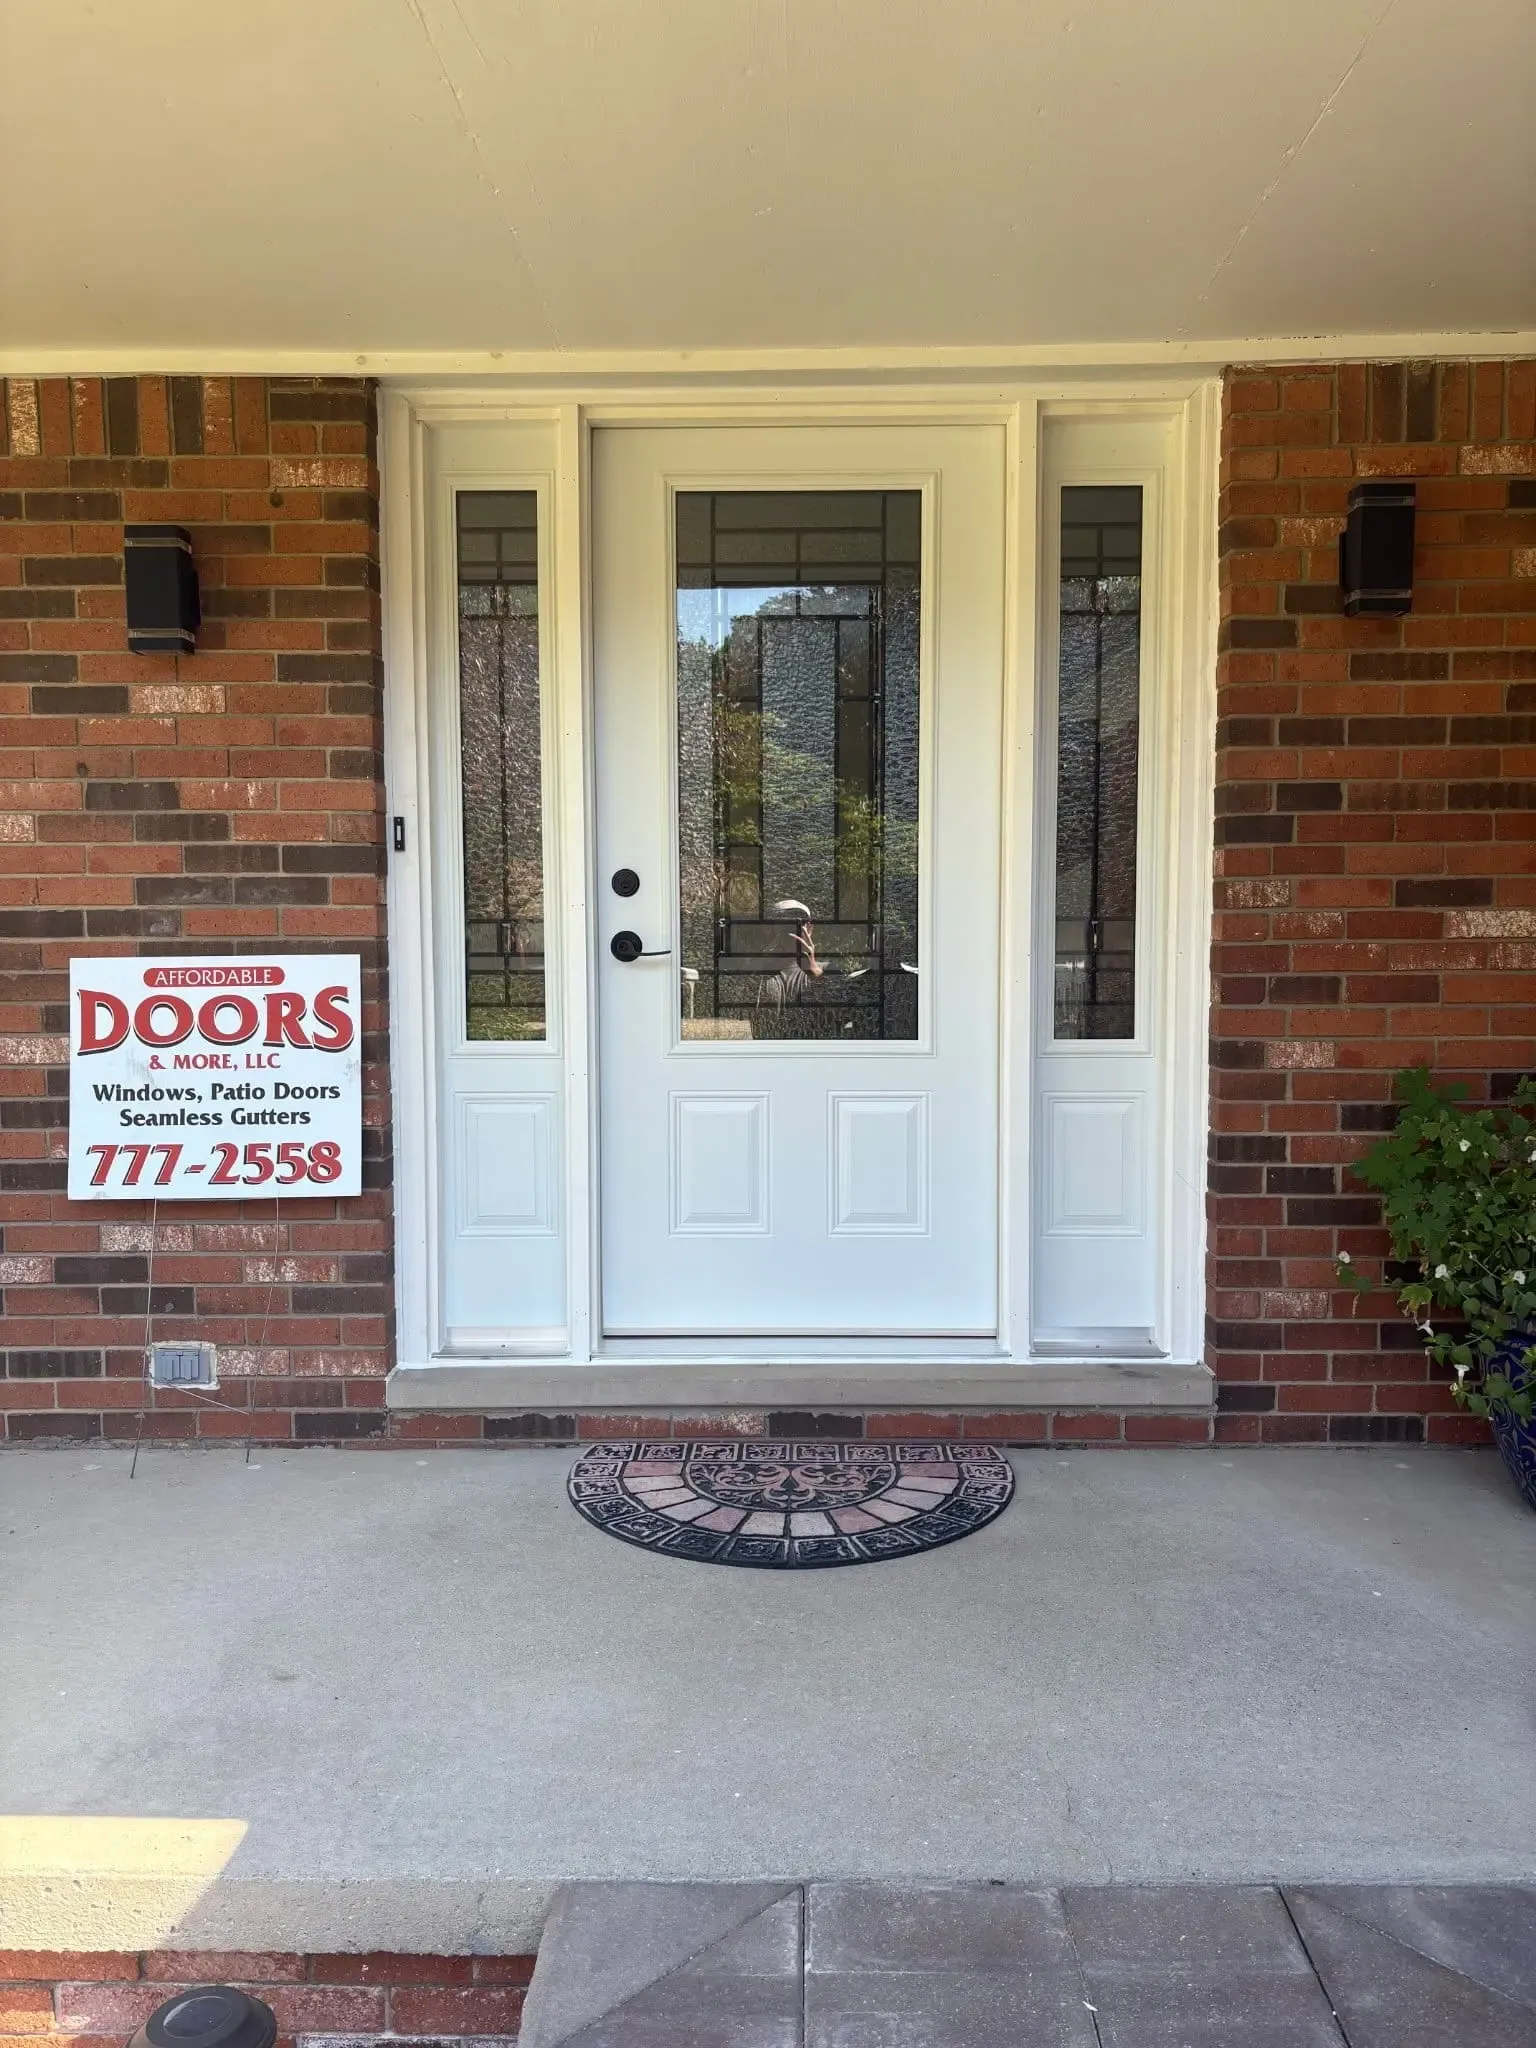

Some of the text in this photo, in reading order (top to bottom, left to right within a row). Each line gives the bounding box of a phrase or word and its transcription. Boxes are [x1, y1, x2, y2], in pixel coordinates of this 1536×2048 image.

[155, 967, 273, 985] AFFORDABLE
[77, 986, 355, 1056] DOORS
[149, 1053, 281, 1071] & MORE, LLC
[92, 1082, 341, 1103] Windows, Patio Doors
[119, 1107, 311, 1126] Seamless Gutters
[86, 1141, 343, 1186] 777-2558
